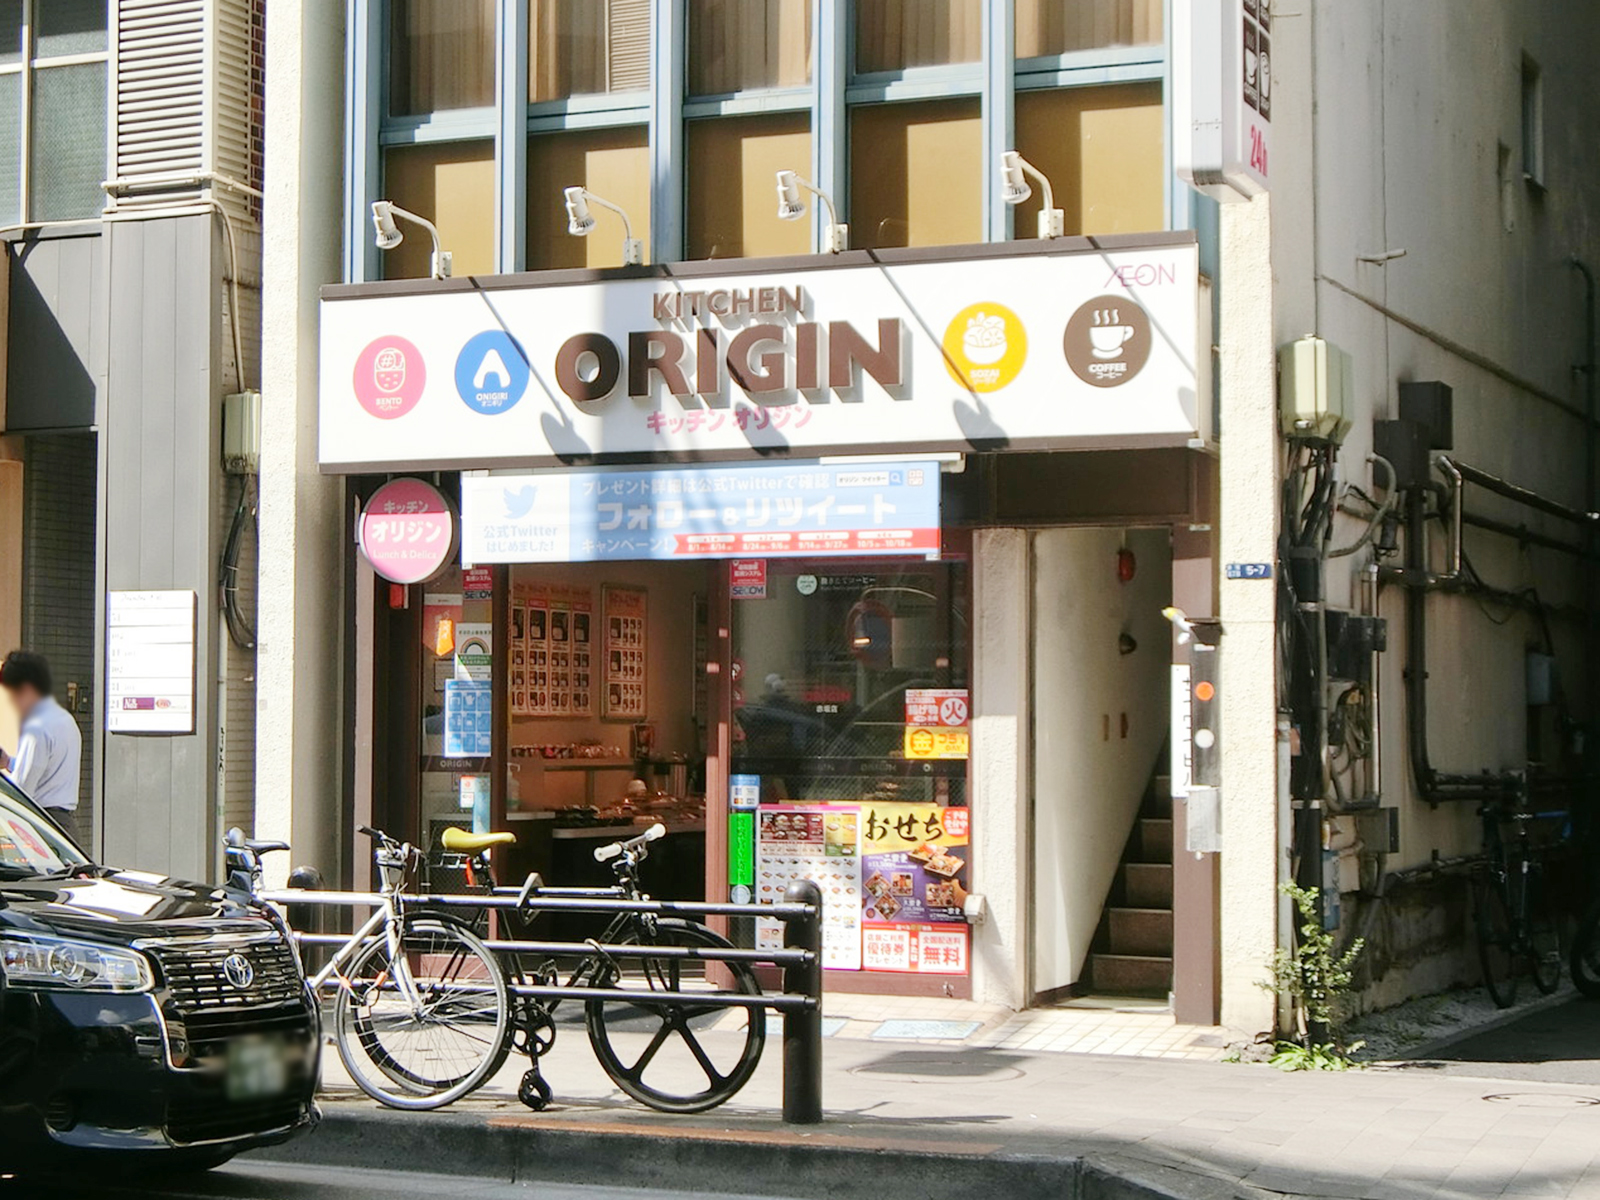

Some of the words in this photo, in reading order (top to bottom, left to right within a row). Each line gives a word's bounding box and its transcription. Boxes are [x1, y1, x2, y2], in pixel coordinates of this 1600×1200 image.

[653, 285, 804, 319] KITCHEN
[554, 317, 903, 402] ORIGIN
[970, 369, 1000, 379] SOZAI
[1088, 363, 1127, 373] COFFEE
[375, 397, 402, 406] BENTO
[475, 392, 508, 401] ONIGIRI
[646, 407, 726, 435] キッチン
[732, 405, 813, 431] オリジン
[384, 501, 429, 514] キッチン
[371, 521, 442, 543] オリジン
[484, 525, 559, 539] 公式Twitter
[486, 541, 555, 554] はじめました!
[582, 538, 669, 554] キャンペーン!
[373, 550, 399, 559] Lunch
[401, 551, 407, 559] &
[410, 550, 437, 559] Delica
[1245, 565, 1266, 576] 5-7
[732, 586, 764, 596] SECOM
[945, 701, 963, 720] 火
[440, 760, 473, 769] ORIGIN
[865, 808, 943, 843] おせち
[923, 946, 960, 967] 無料
